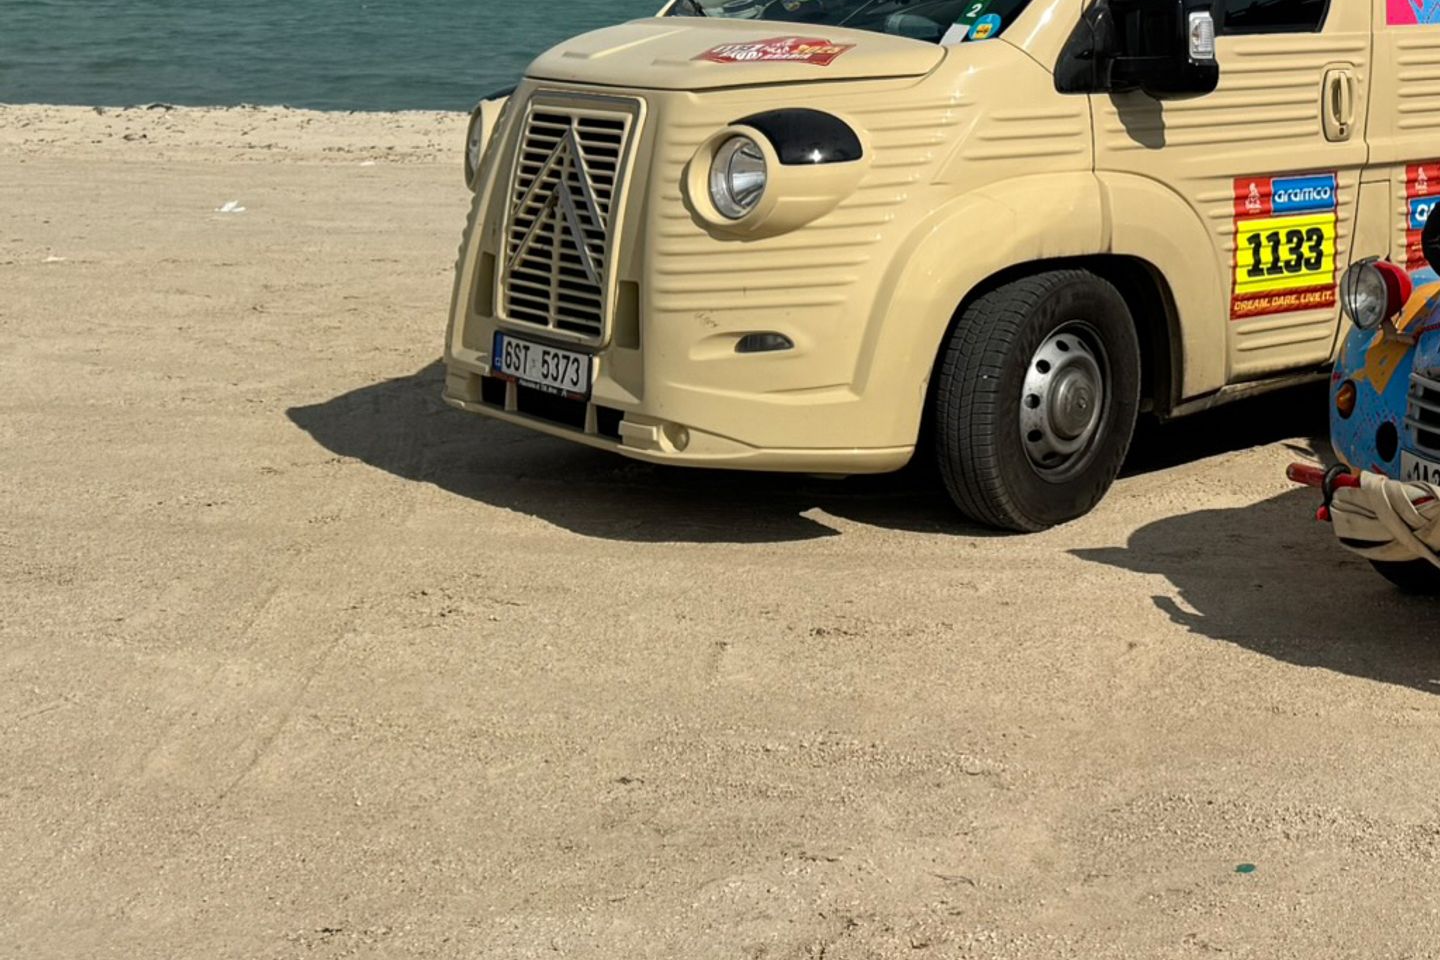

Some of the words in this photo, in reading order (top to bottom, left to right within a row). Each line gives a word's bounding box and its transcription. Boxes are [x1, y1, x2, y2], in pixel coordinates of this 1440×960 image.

[966, 3, 982, 17] 2
[1275, 185, 1331, 203] aramco
[1246, 227, 1324, 278] 1133
[505, 341, 530, 374] 6ST
[541, 350, 580, 386] 5373
